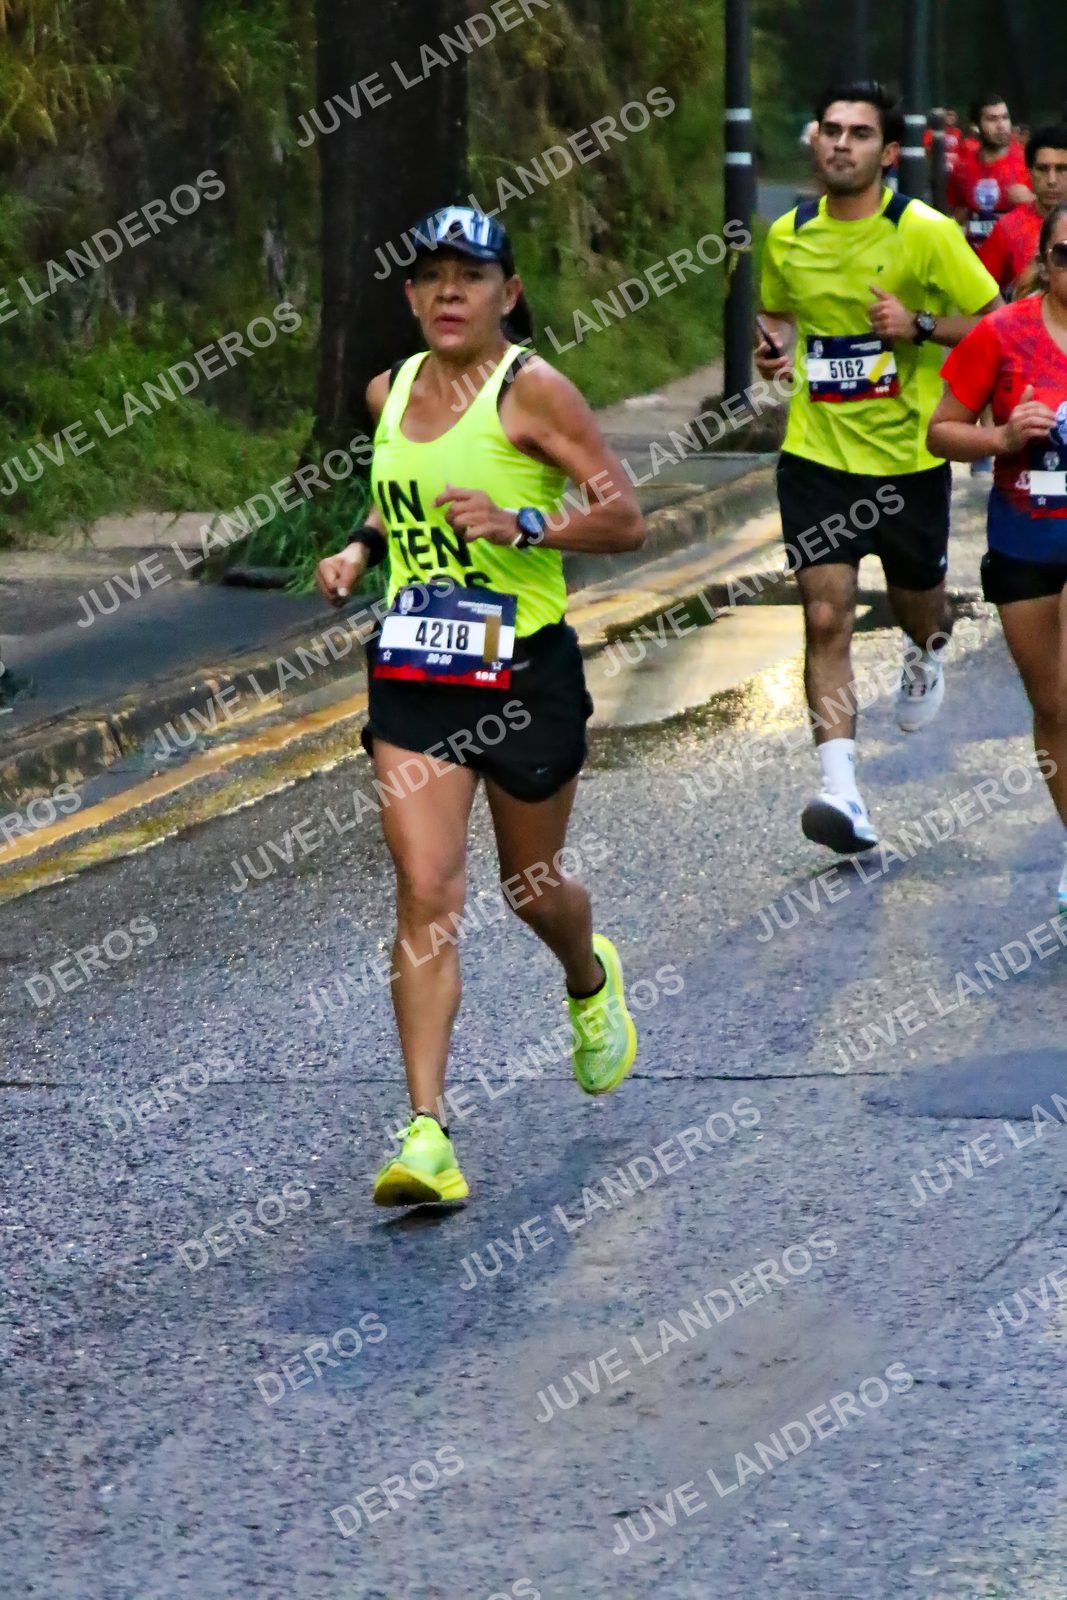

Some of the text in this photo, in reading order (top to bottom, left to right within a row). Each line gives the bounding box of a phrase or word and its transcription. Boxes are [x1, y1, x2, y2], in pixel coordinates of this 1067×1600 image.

[829, 359, 866, 379] 5162
[377, 479, 426, 525] IN
[391, 526, 473, 571] TEN
[416, 620, 469, 651] 4218
[475, 671, 497, 682] 10K
